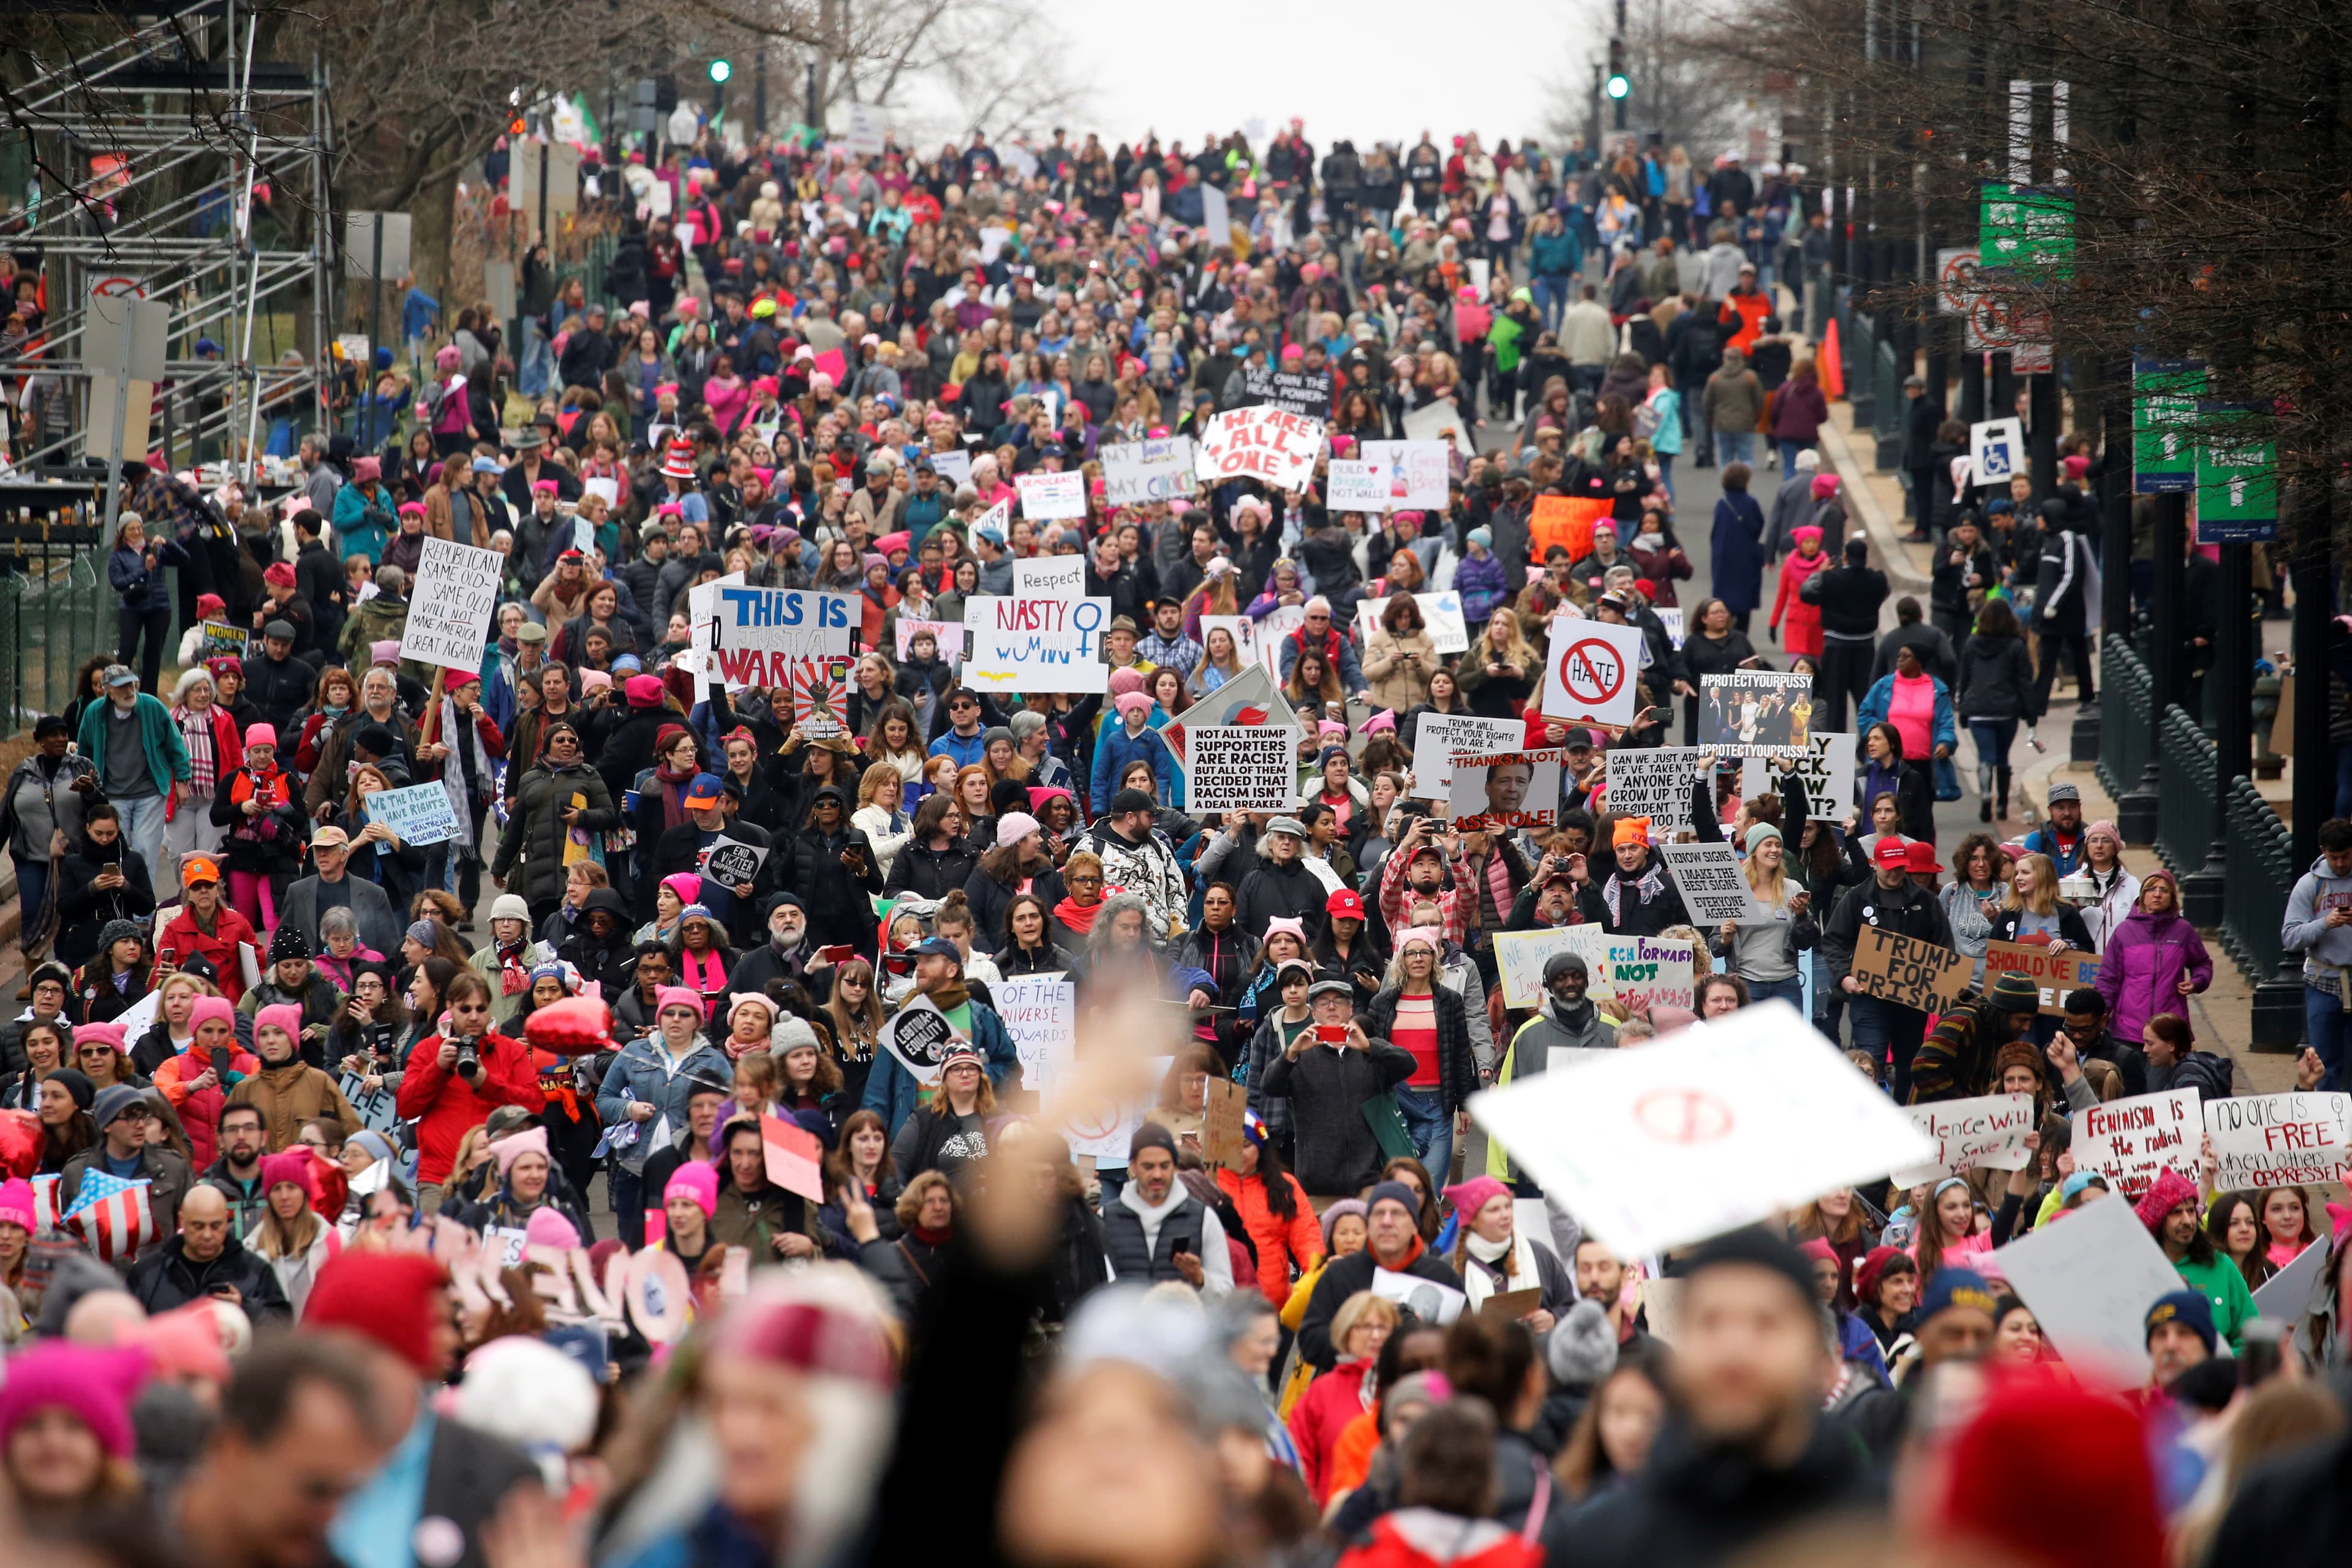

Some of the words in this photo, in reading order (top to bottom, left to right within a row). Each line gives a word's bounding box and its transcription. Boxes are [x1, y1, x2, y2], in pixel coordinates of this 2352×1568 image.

[1246, 369, 1272, 384] WE
[1273, 373, 1302, 387] OWN
[1306, 377, 1329, 390] THE
[1246, 383, 1276, 396] REAL
[1264, 410, 1310, 437] ARE
[1229, 425, 1288, 453] ALL
[1104, 447, 1130, 463] MY
[1221, 451, 1280, 475] ONE
[1334, 464, 1363, 475] BUILD
[1022, 475, 1080, 487] DEMOCRACY
[1109, 478, 1137, 497] MY
[1357, 489, 1384, 499] WALLS
[424, 540, 499, 574] REPUBLICAN
[423, 561, 459, 581] SAME
[1023, 567, 1080, 590] Respect
[431, 583, 465, 605] SAME
[466, 592, 491, 615] OLD
[423, 601, 445, 617] WILL
[451, 609, 475, 624] NOT
[997, 600, 1068, 631] NASTY
[206, 624, 245, 641] WOMEN
[412, 615, 436, 628] MAKE
[436, 620, 477, 642] AMERICA
[407, 634, 442, 654] GREAT
[443, 641, 483, 665] AGAIN!
[737, 627, 802, 654] JUST
[805, 630, 826, 655] A
[992, 636, 1071, 664] WOMAN
[1572, 659, 1615, 687] HATE
[1700, 674, 1814, 689] #PROTECTYOURPUSSY
[1196, 730, 1220, 739] NOT
[1222, 730, 1242, 739] ALL
[1426, 726, 1460, 736] PROTECT
[1463, 729, 1483, 738] YOUR
[1486, 731, 1515, 742] RIGHTS
[1448, 719, 1474, 728] TRUMP
[1477, 722, 1494, 731] WILL
[1196, 741, 1286, 752] SUPPORTERS
[1698, 743, 1810, 758] #PROTECTYOURPUSSY
[1196, 753, 1226, 764] ARE
[1231, 753, 1289, 766] RACIST,
[1454, 753, 1513, 769] THANKS
[1514, 753, 1526, 764] A
[1528, 751, 1559, 763] LOT,
[1612, 755, 1632, 765] CAN
[1635, 755, 1650, 764] WE
[1654, 753, 1678, 763] JUST
[1612, 764, 1645, 775] WE'VE
[1649, 764, 1681, 774] TAKEN
[1194, 777, 1251, 786] DECIDED
[1254, 776, 1288, 785] THAT
[1194, 788, 1249, 797] RACISM
[1253, 788, 1287, 797] ISN'T
[1611, 788, 1649, 802] GROW
[1653, 788, 1670, 800] UP
[1675, 788, 1689, 800] TO
[368, 797, 386, 812] WE
[387, 793, 406, 807] THE
[385, 808, 407, 823] HAVE
[410, 798, 448, 815] RIGHTS:
[1454, 810, 1554, 831] ASSHOLE!
[1650, 814, 1673, 827] TOO
[407, 829, 442, 845] RELIGIOUS
[733, 846, 750, 858] END
[1667, 853, 1672, 863] I
[1672, 853, 1702, 863] KNOW
[1703, 851, 1735, 862] SIGNS.
[712, 861, 752, 880] SUPPRESSION
[1678, 870, 1684, 880] I
[1685, 869, 1714, 879] MAKE
[1715, 868, 1736, 878] THE
[1683, 880, 1708, 891] BEST
[1709, 879, 1742, 890] SIGNS.
[682, 904, 706, 914] MARCH
[1694, 896, 1746, 907] EVERYONE
[1705, 908, 1746, 919] AGREES.
[1501, 939, 1524, 968] WE
[1638, 938, 1692, 962] FORWARD
[1872, 928, 1960, 973] TRUMP
[533, 963, 557, 974] MARCH
[1616, 963, 1659, 981] NOT
[1986, 949, 2071, 980] SHOULD'VE
[1887, 958, 1936, 992] FOR
[1003, 987, 1028, 1005] OF
[1035, 985, 1066, 1003] THE
[1857, 969, 1958, 1016] PRISON
[895, 1011, 933, 1046] LGBTQIA+
[905, 1020, 944, 1057] EQUALITY
[1020, 1048, 1049, 1060] WE
[2247, 1098, 2283, 1126] one
[2264, 1121, 2334, 1152] FREE
[2218, 1152, 2269, 1172] when
[2276, 1150, 2324, 1169] others
[2219, 1170, 2248, 1190] are
